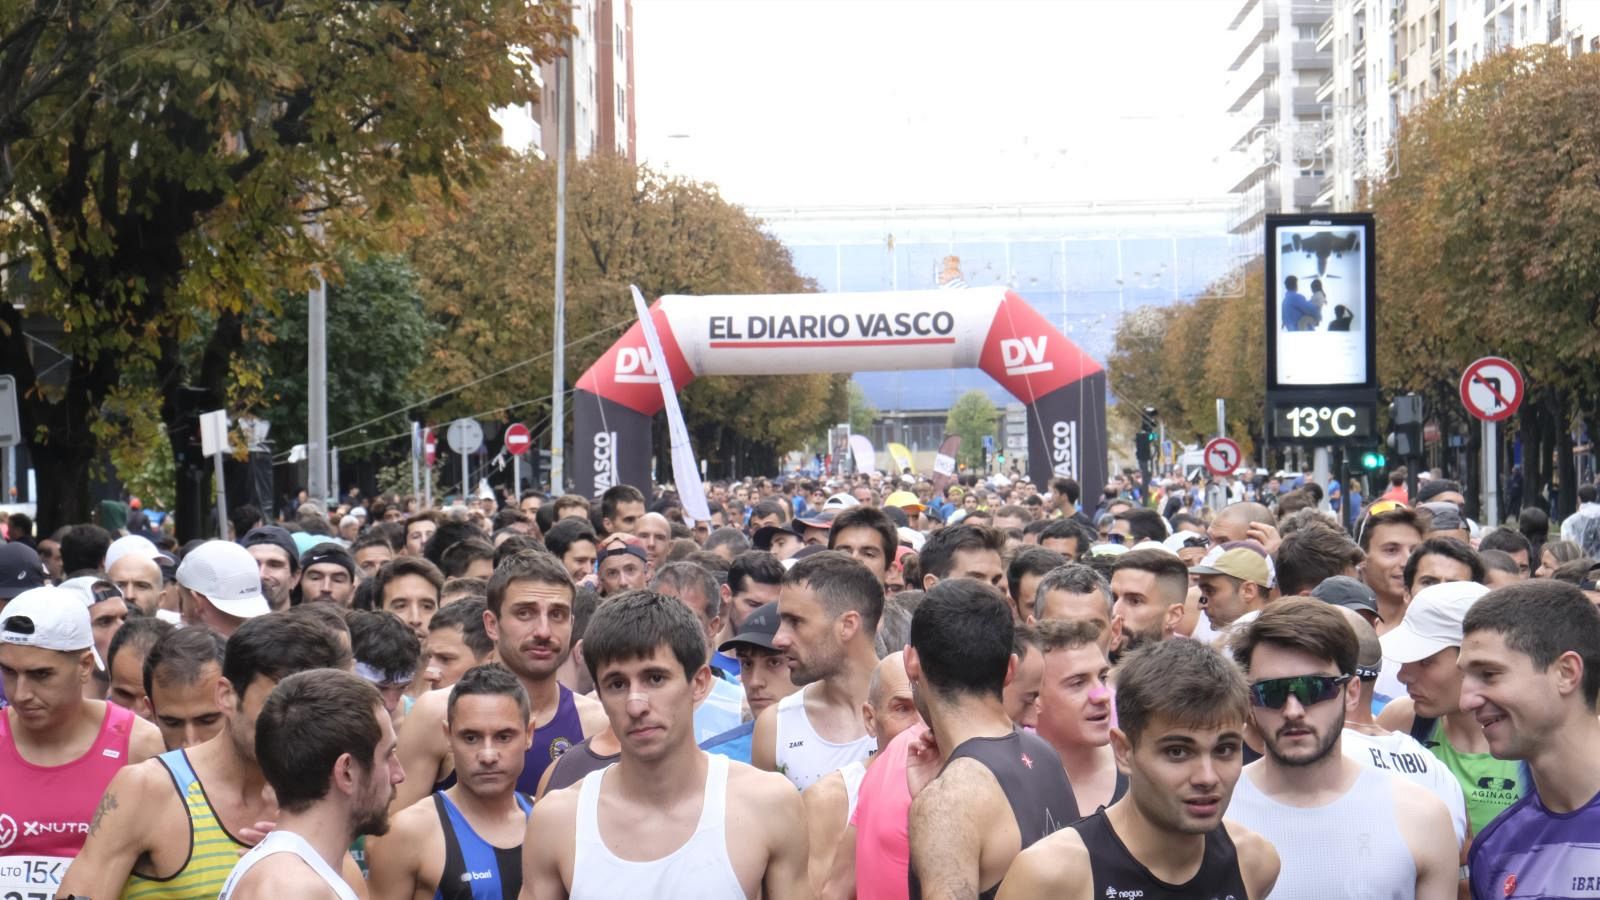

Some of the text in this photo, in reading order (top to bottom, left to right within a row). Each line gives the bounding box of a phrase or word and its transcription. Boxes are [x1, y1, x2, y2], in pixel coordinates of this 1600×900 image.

[709, 311, 954, 339] EL DIARIO VASCO
[1001, 336, 1047, 367] DV
[1286, 406, 1356, 437] 13°C
[1053, 421, 1071, 478] ASCO
[1369, 747, 1391, 770] EL
[1471, 790, 1520, 801] AGINAGA
